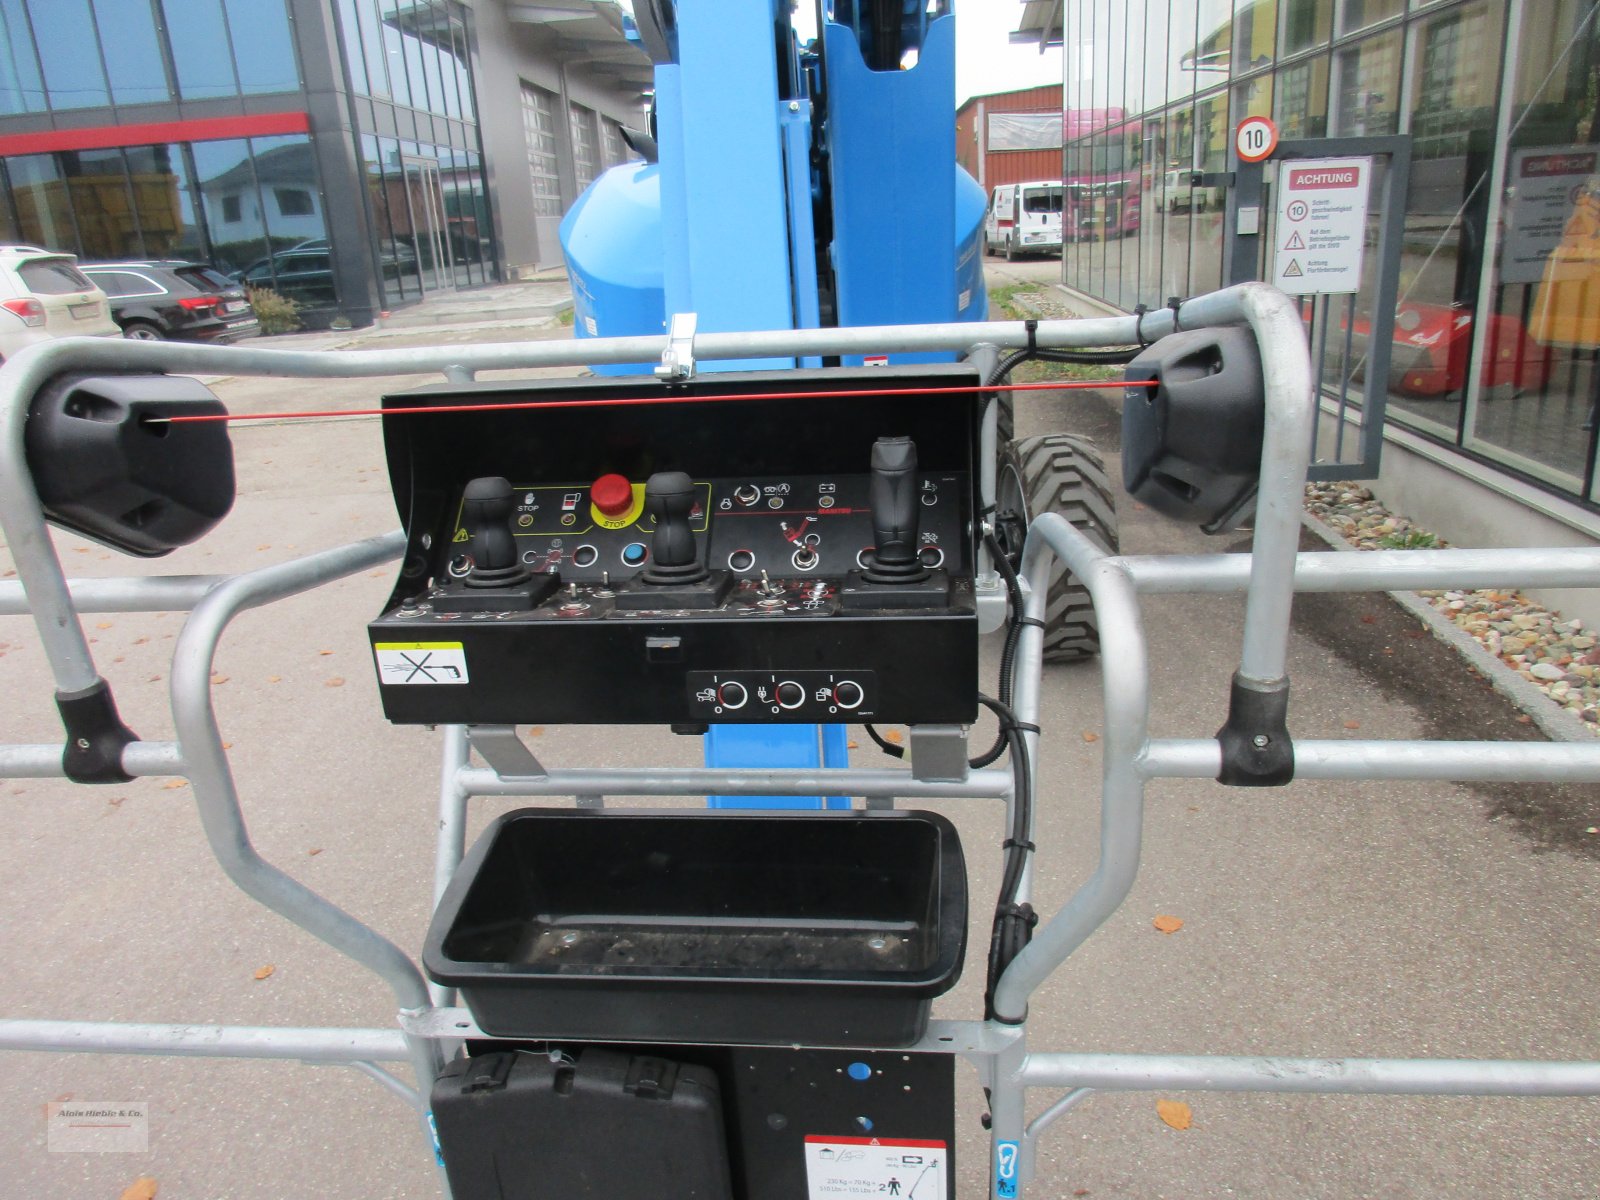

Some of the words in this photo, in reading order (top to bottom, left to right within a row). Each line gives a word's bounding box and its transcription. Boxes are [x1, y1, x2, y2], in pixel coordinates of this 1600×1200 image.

[1245, 129, 1264, 150] 10
[1295, 172, 1354, 186] ACHTUNG
[1291, 205, 1304, 216] 10
[603, 520, 626, 528] STOP
[879, 1183, 886, 1191] 2
